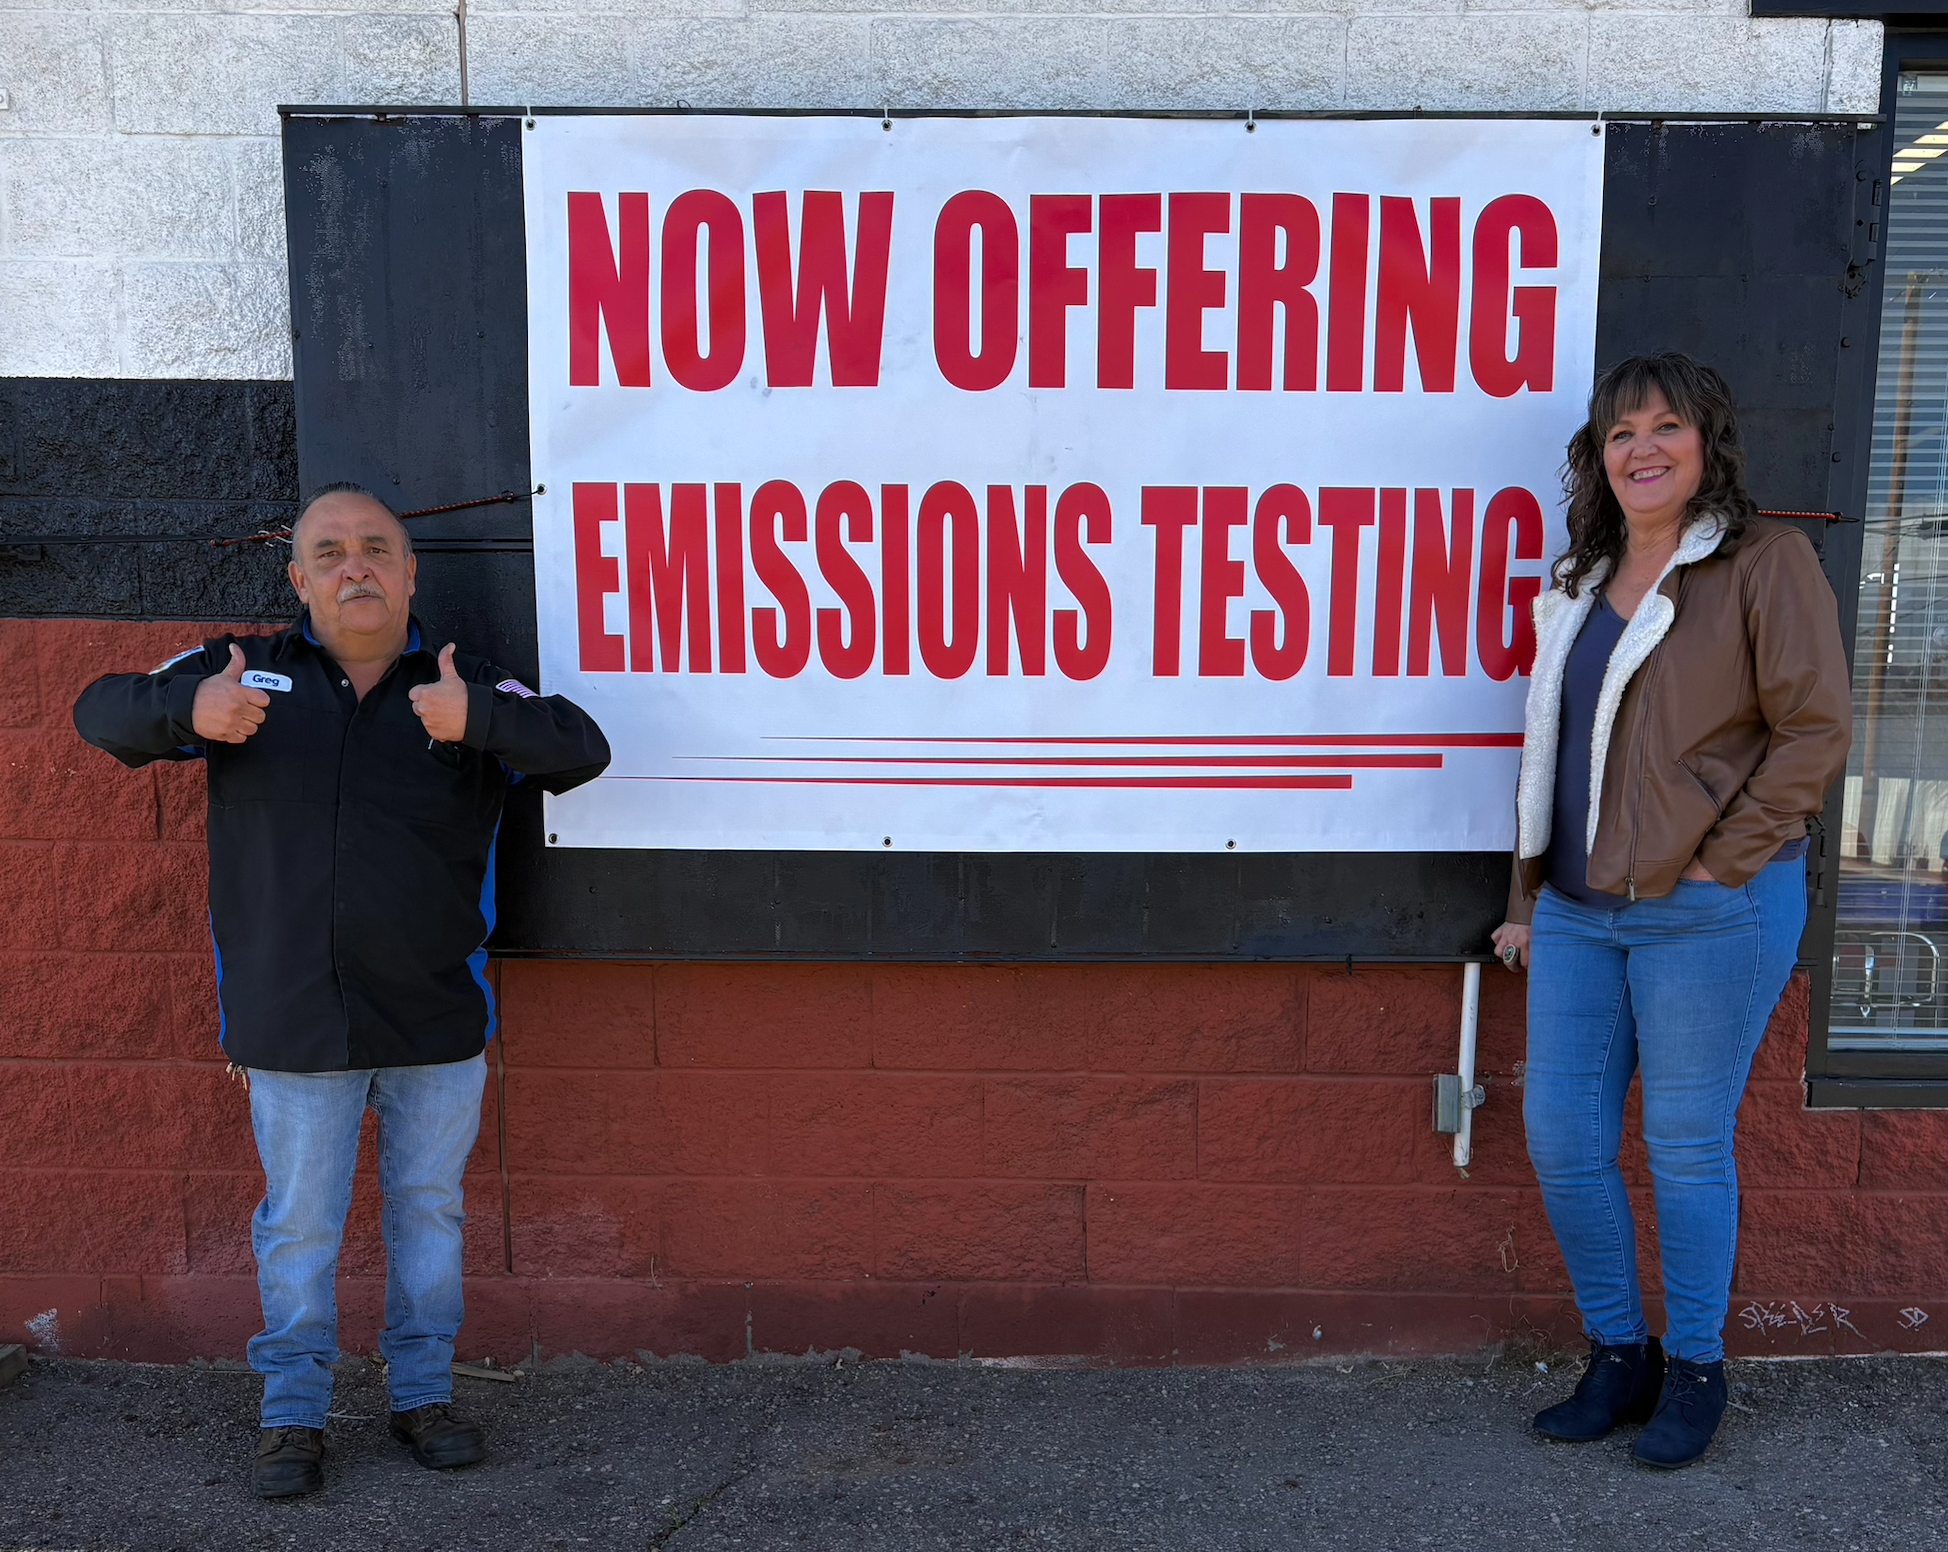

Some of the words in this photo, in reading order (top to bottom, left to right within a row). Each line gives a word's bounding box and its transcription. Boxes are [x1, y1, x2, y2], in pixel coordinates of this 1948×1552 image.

[568, 189, 895, 392] NOW
[933, 190, 1558, 398] OFFERING
[252, 674, 280, 687] Greg
[572, 479, 1112, 680] EMISSIONS
[1141, 484, 1544, 682] TESTING
